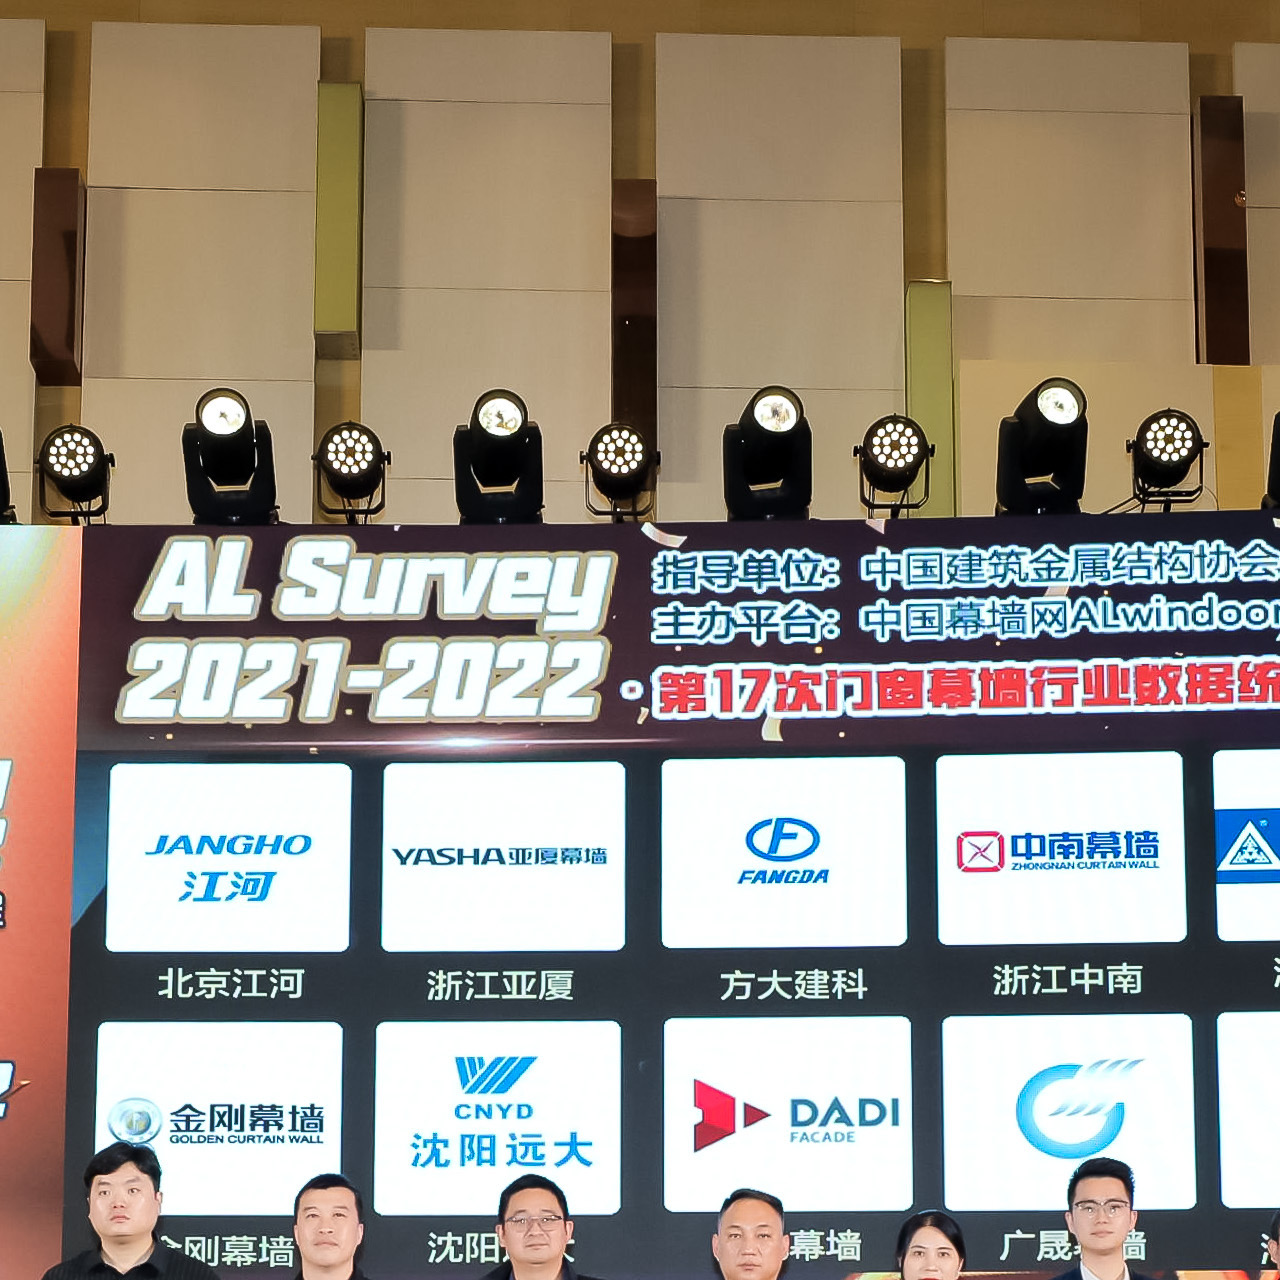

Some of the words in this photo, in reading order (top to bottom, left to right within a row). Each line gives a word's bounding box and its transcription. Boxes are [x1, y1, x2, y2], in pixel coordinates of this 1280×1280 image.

[136, 536, 261, 620] AL
[273, 535, 618, 635] Survey
[116, 636, 609, 723] 2021-2022
[145, 834, 312, 856] JANGHO
[1010, 830, 1160, 860] 中南幕墙
[737, 868, 830, 885] FANGDA
[1010, 861, 1075, 871] ZHONGNAN
[1076, 861, 1127, 870] CURTAIN
[1128, 860, 1161, 870] WALL
[178, 870, 277, 902] 江河
[157, 967, 306, 1000] 北京江河
[426, 969, 575, 1001] 浙江亚厦
[719, 967, 869, 1001] 方大建科
[992, 962, 1144, 996] 浙江中南
[169, 1102, 324, 1134] 金刚幕墙
[454, 1103, 534, 1120] CNYD
[790, 1096, 900, 1128] DADI
[169, 1134, 224, 1144] GOLDEN
[227, 1134, 285, 1144] CURTAIN
[288, 1134, 324, 1144] WALL
[410, 1132, 594, 1168] 沈阳远大
[789, 1130, 856, 1143] FACADE
